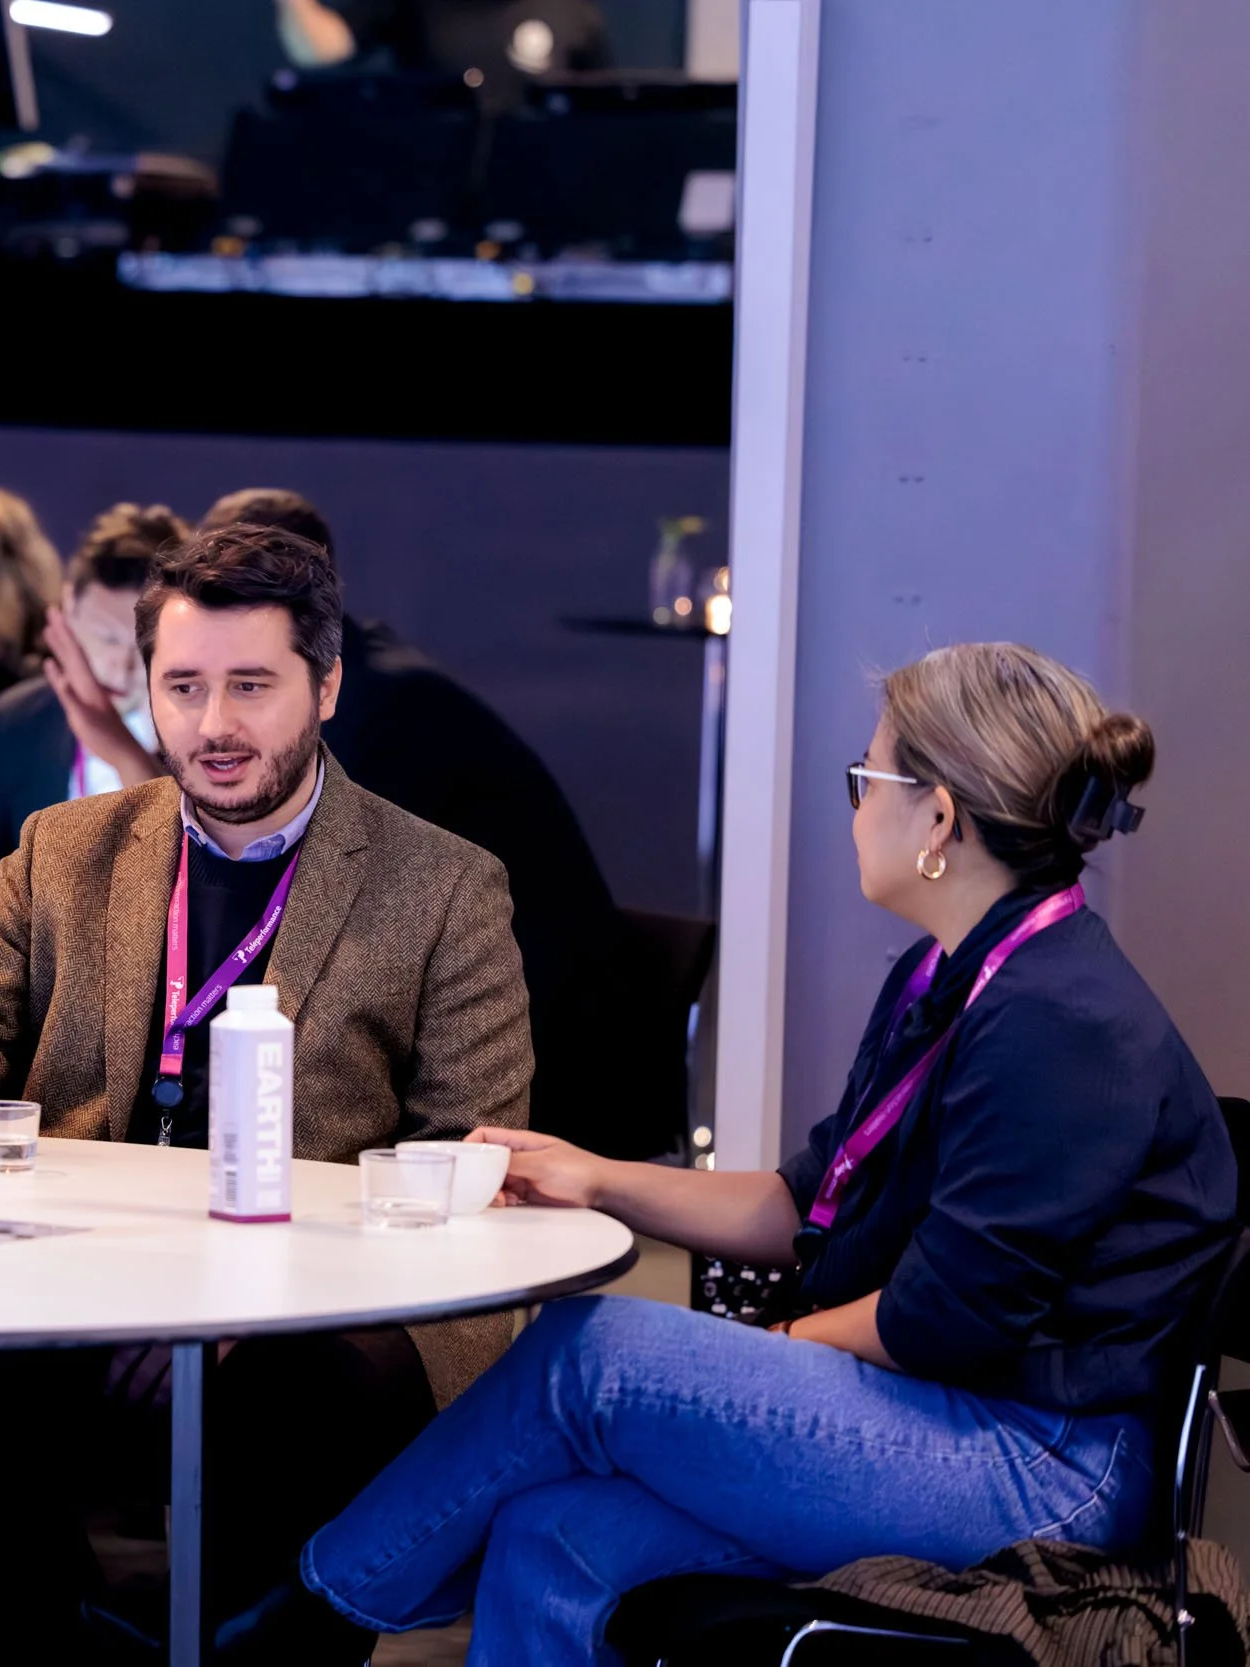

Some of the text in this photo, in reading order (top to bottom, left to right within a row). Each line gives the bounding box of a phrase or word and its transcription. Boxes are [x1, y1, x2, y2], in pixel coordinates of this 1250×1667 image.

[244, 905, 282, 954] Teleperformance
[169, 990, 180, 1025] Teleperf
[256, 1041, 283, 1183] EARTH
